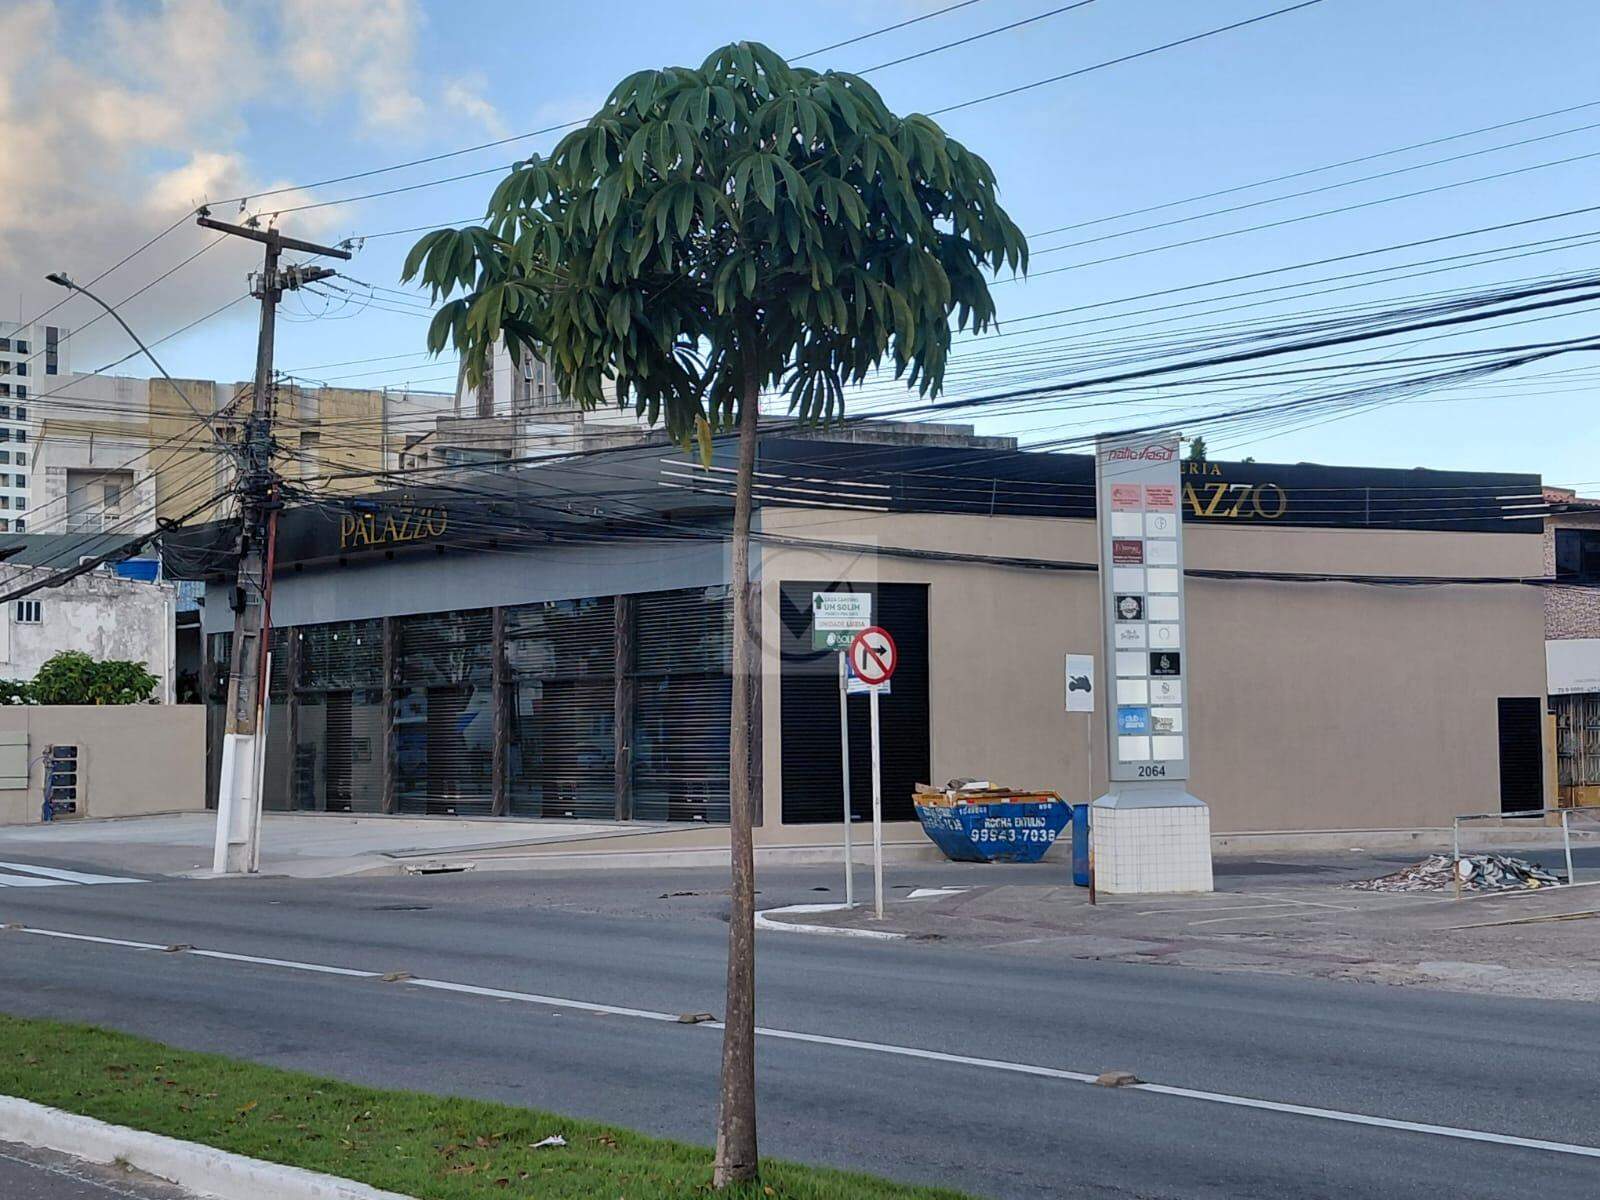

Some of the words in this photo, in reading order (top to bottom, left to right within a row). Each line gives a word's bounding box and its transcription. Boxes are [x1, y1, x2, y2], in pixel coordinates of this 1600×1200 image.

[1182, 482, 1287, 519] AZZO
[340, 504, 449, 549] PALAZZO
[1138, 765, 1166, 777] 2064
